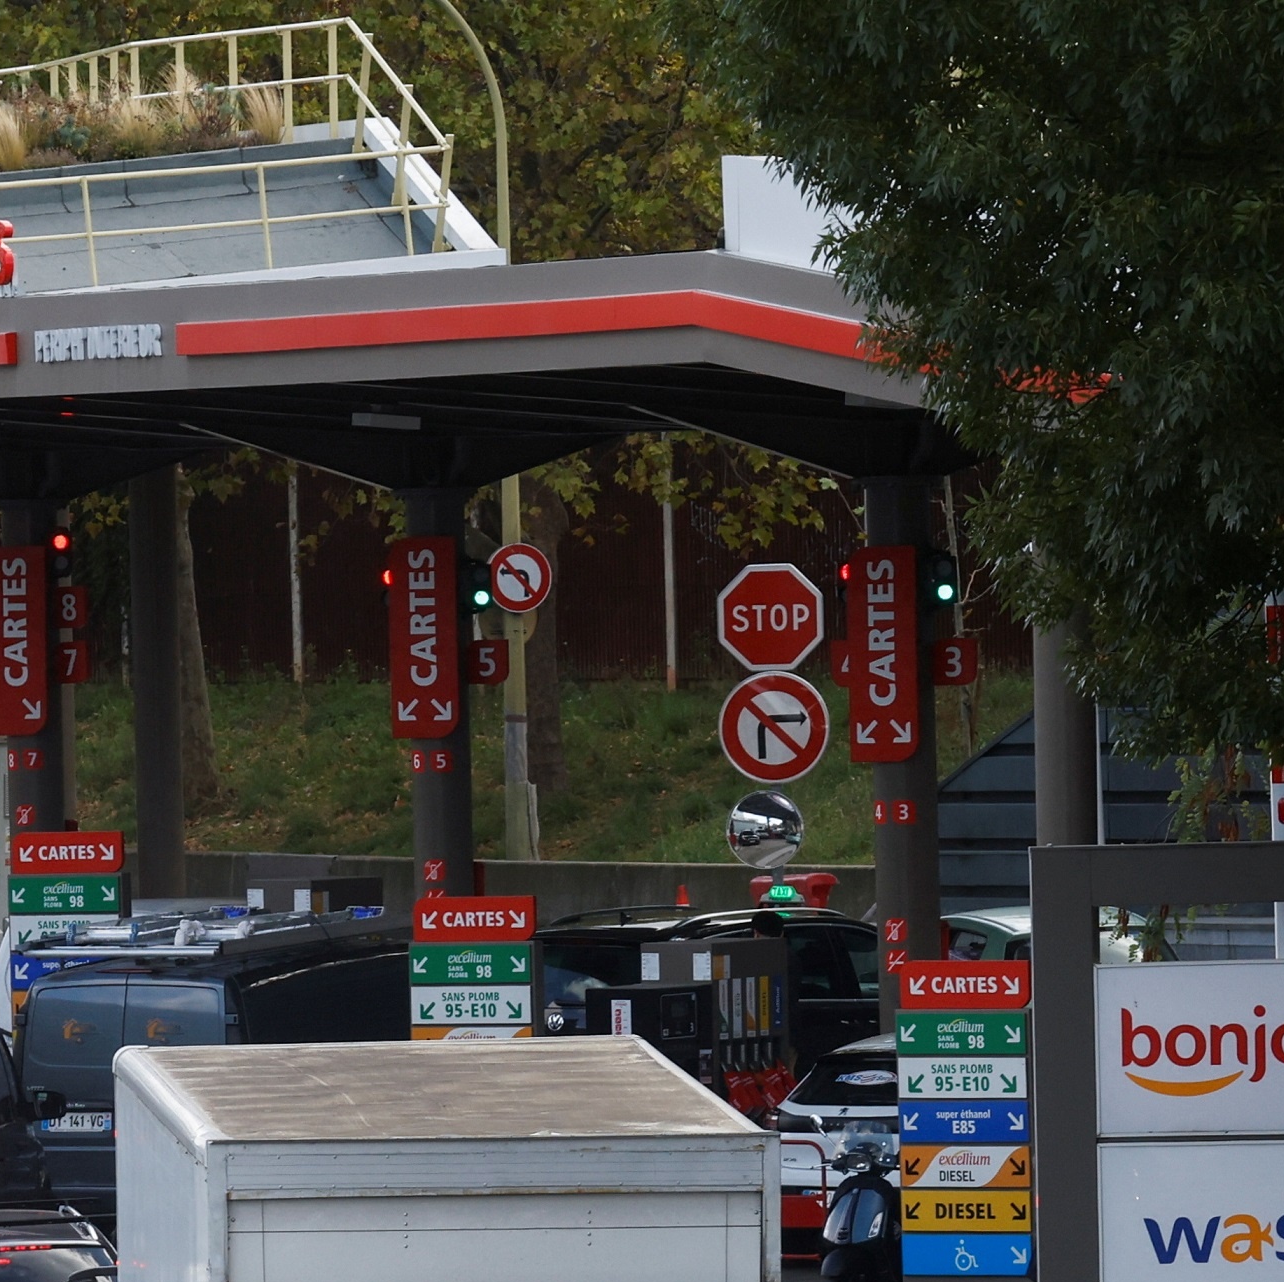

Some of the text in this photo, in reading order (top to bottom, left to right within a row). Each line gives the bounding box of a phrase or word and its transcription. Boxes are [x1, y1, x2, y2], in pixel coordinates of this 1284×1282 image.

[61, 593, 77, 621] 8
[2, 557, 29, 687] CARTES
[408, 548, 438, 687] CARTES
[732, 604, 810, 633] STOP
[867, 559, 896, 707] CARTES
[62, 650, 77, 676] 7
[478, 647, 496, 677] 5
[945, 646, 963, 678] 3
[27, 752, 37, 766] 7
[413, 753, 446, 769] 6 5
[875, 804, 909, 820] 4 3
[38, 845, 96, 861] CARTES
[43, 882, 84, 894] excellium
[69, 896, 84, 908] 98
[38, 920, 59, 929] SANS
[442, 911, 505, 928] CARTES
[448, 951, 492, 964] excellium
[475, 965, 492, 978] 98
[931, 976, 998, 994] CARTES
[442, 992, 500, 1002] SANS PLOMB
[445, 1003, 497, 1018] 95-E10
[937, 1020, 985, 1035] excellium
[968, 1035, 985, 1050] 98
[931, 1063, 994, 1074] SANS PLOMB
[934, 1077, 990, 1092] 95-E10
[936, 1108, 991, 1121] super éthanol
[952, 1121, 976, 1135] E85
[938, 1151, 991, 1167] excellium
[939, 1170, 976, 1183] DIESEL
[935, 1202, 996, 1220] DIESEL
